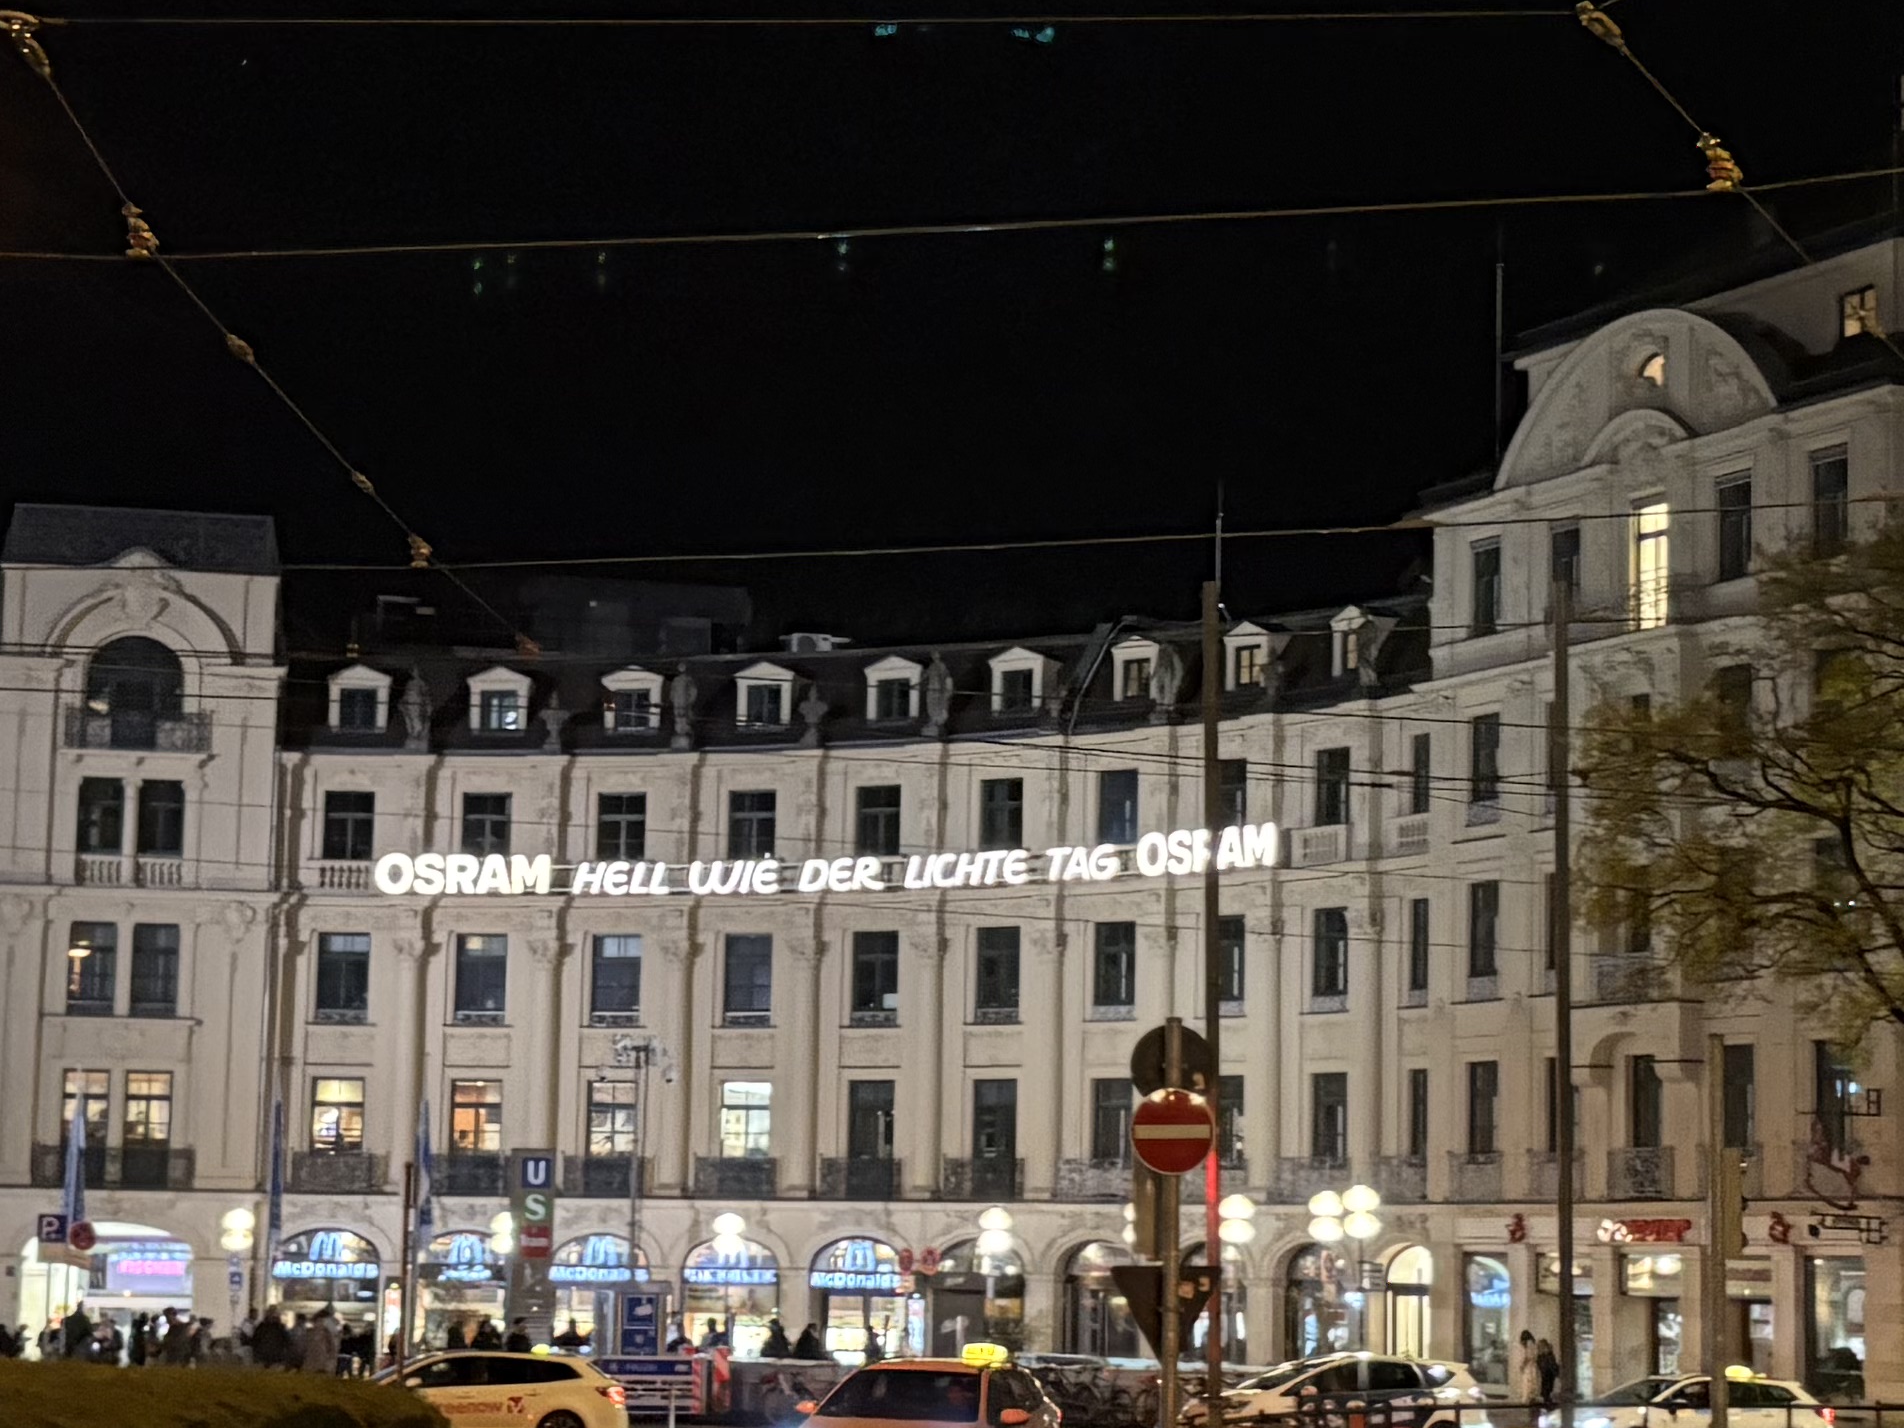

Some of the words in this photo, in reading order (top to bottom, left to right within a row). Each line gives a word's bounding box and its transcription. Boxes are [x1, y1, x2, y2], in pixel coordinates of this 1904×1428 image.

[375, 853, 551, 895] OSRAM
[571, 860, 670, 895] HELL
[688, 859, 781, 895] WIE
[798, 857, 884, 892] DER
[904, 849, 1030, 889] LICHTE
[1046, 843, 1121, 881] TAG
[527, 1160, 546, 1185] U
[525, 1194, 546, 1221] S
[42, 1217, 60, 1240] P
